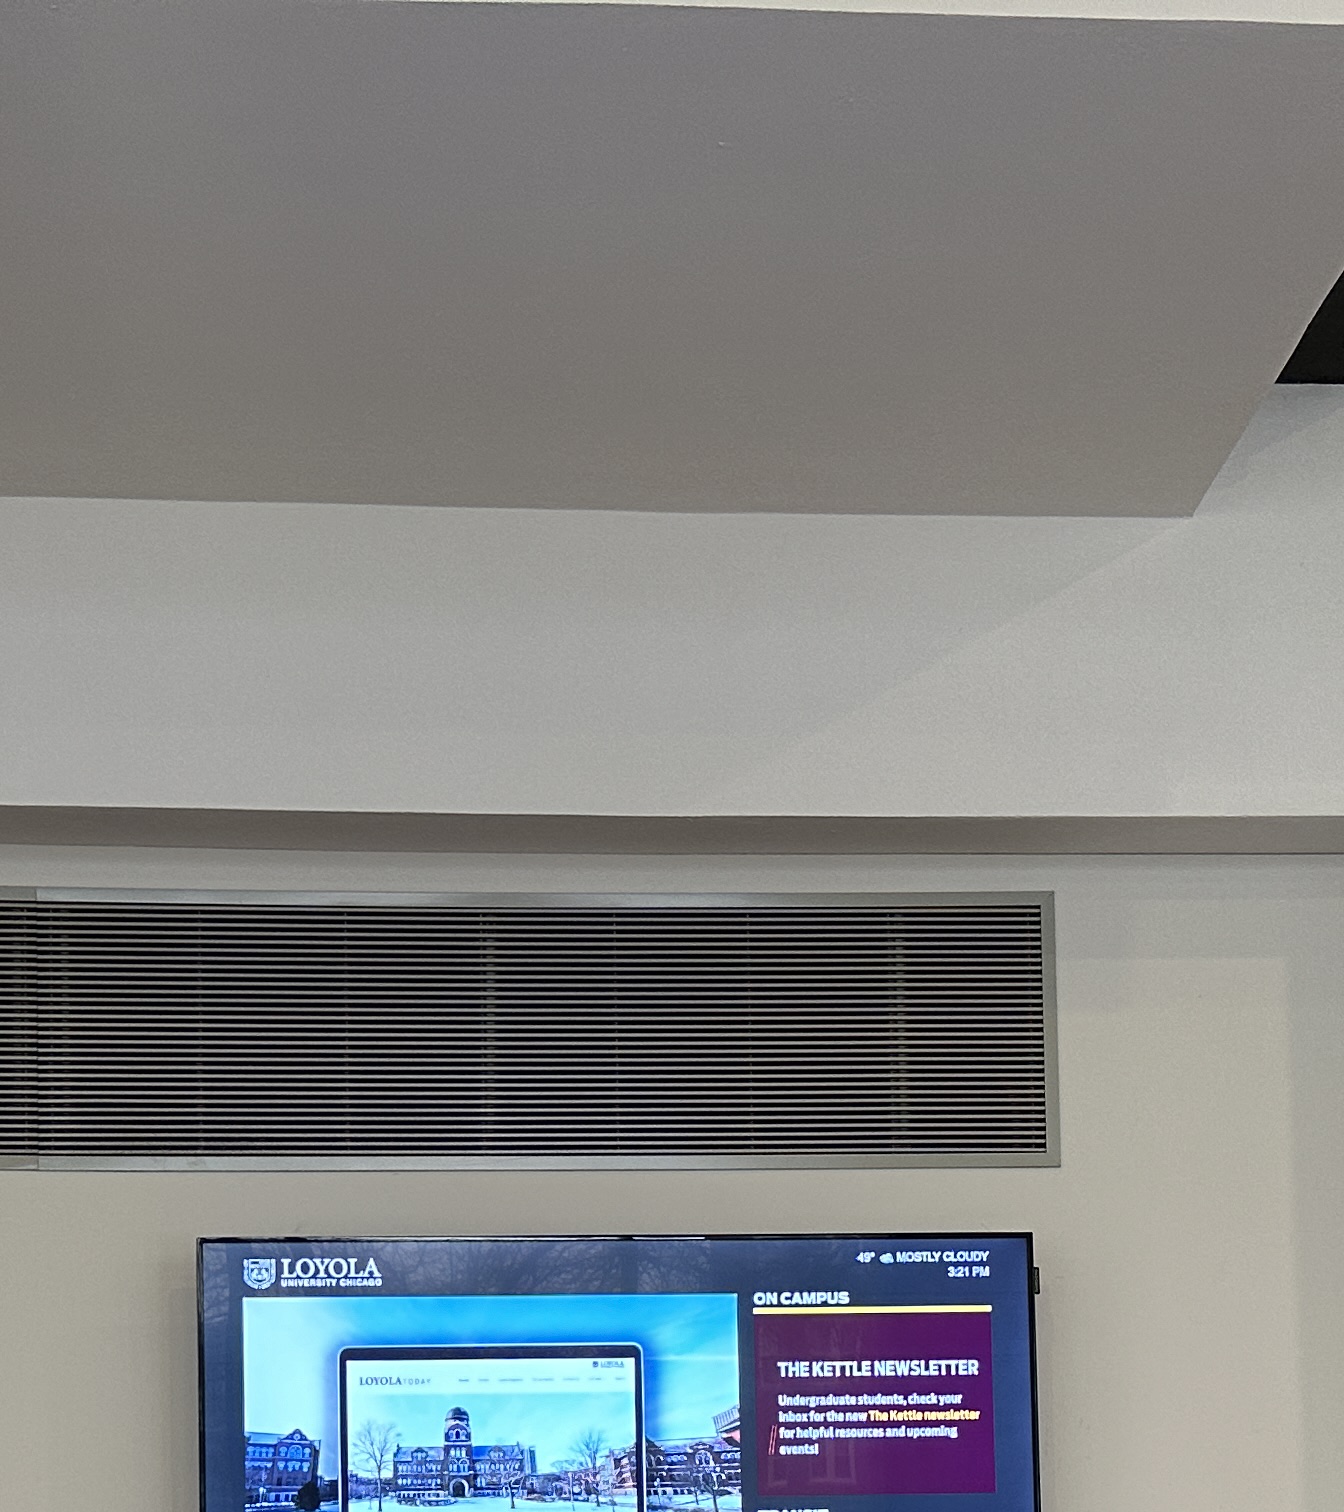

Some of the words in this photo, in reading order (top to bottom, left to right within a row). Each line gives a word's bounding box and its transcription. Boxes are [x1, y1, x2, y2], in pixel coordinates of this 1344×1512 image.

[896, 1251, 940, 1263] MOSTLY
[943, 1250, 989, 1262] CLOUDY
[280, 1257, 382, 1278] LOYOLA
[947, 1266, 970, 1278] 3:21
[972, 1266, 990, 1277] PM
[280, 1278, 337, 1287] UNIVERSITY
[339, 1277, 383, 1287] CHICAGO
[753, 1292, 777, 1305] ON
[780, 1291, 850, 1305] CAMPUS
[777, 1361, 810, 1377] THE
[812, 1360, 871, 1377] KETTLE
[873, 1359, 979, 1376] NEWSLETTER
[778, 1394, 856, 1407] Undergraduate
[857, 1394, 907, 1406] students,
[908, 1393, 937, 1405] check
[938, 1394, 962, 1406] your
[809, 1410, 825, 1422] for
[826, 1410, 844, 1422] the
[845, 1411, 868, 1422] new
[868, 1410, 888, 1421] The
[889, 1409, 923, 1421] Kettle
[924, 1408, 980, 1421] newsletter
[779, 1427, 795, 1439] for
[796, 1426, 834, 1440] helpful
[835, 1428, 884, 1438] resources
[885, 1426, 906, 1437] and
[907, 1425, 958, 1438] upcoming
[779, 1443, 818, 1455] events!
